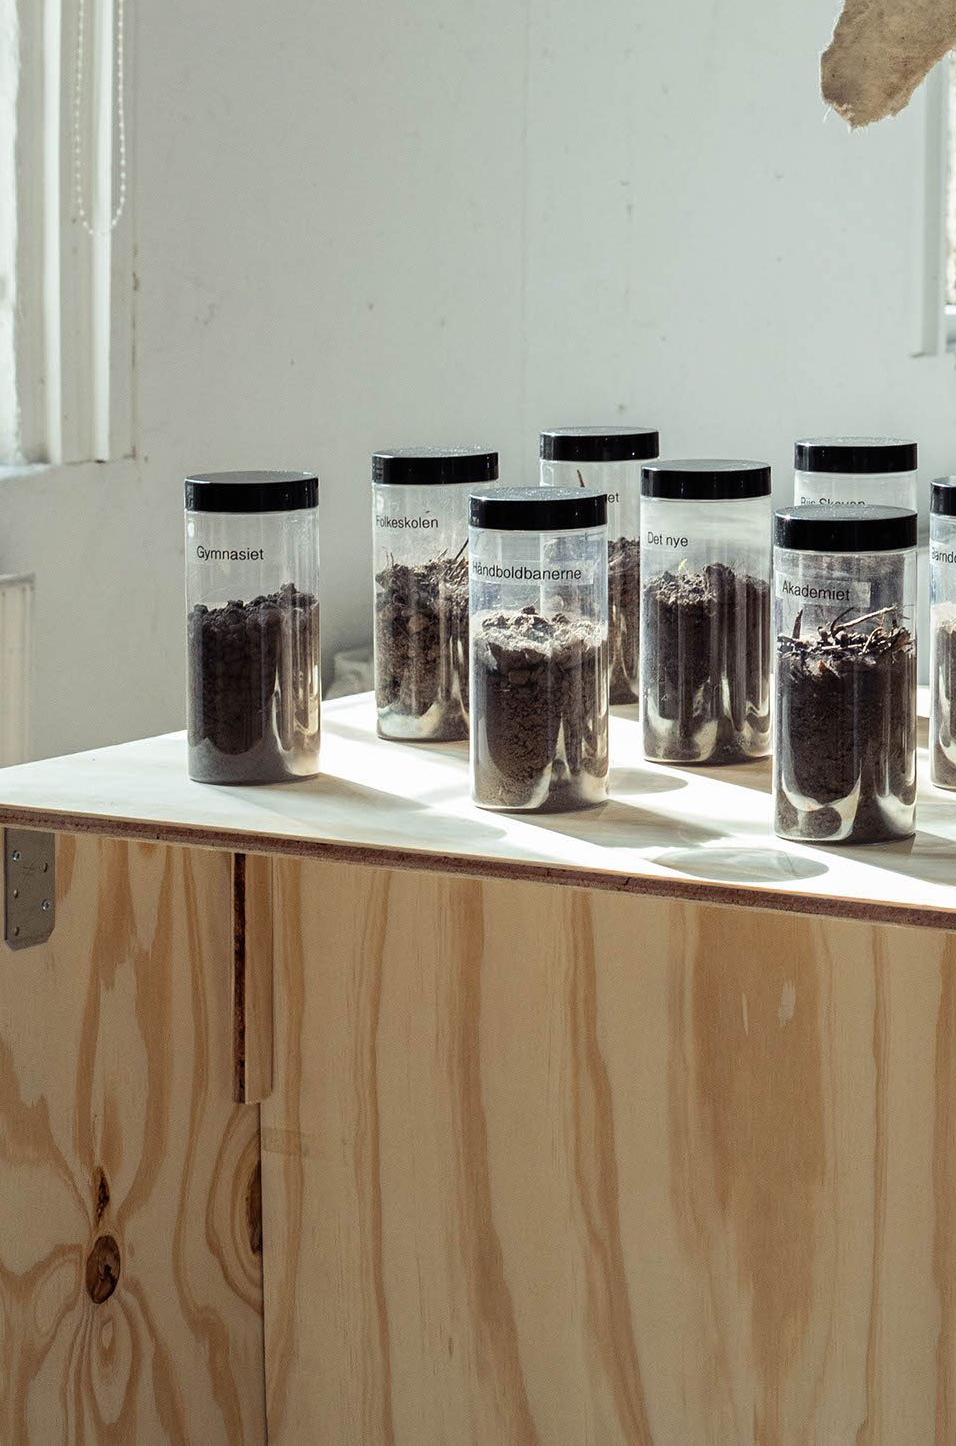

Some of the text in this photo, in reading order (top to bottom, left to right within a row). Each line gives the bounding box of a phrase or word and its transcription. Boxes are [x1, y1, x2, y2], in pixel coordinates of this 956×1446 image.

[375, 515, 439, 529] Folkeskolen
[647, 532, 689, 547] Det nye
[196, 545, 264, 561] Gymnasiet
[472, 561, 582, 580] Håndboldbanerne
[782, 580, 850, 600] Akademiet
